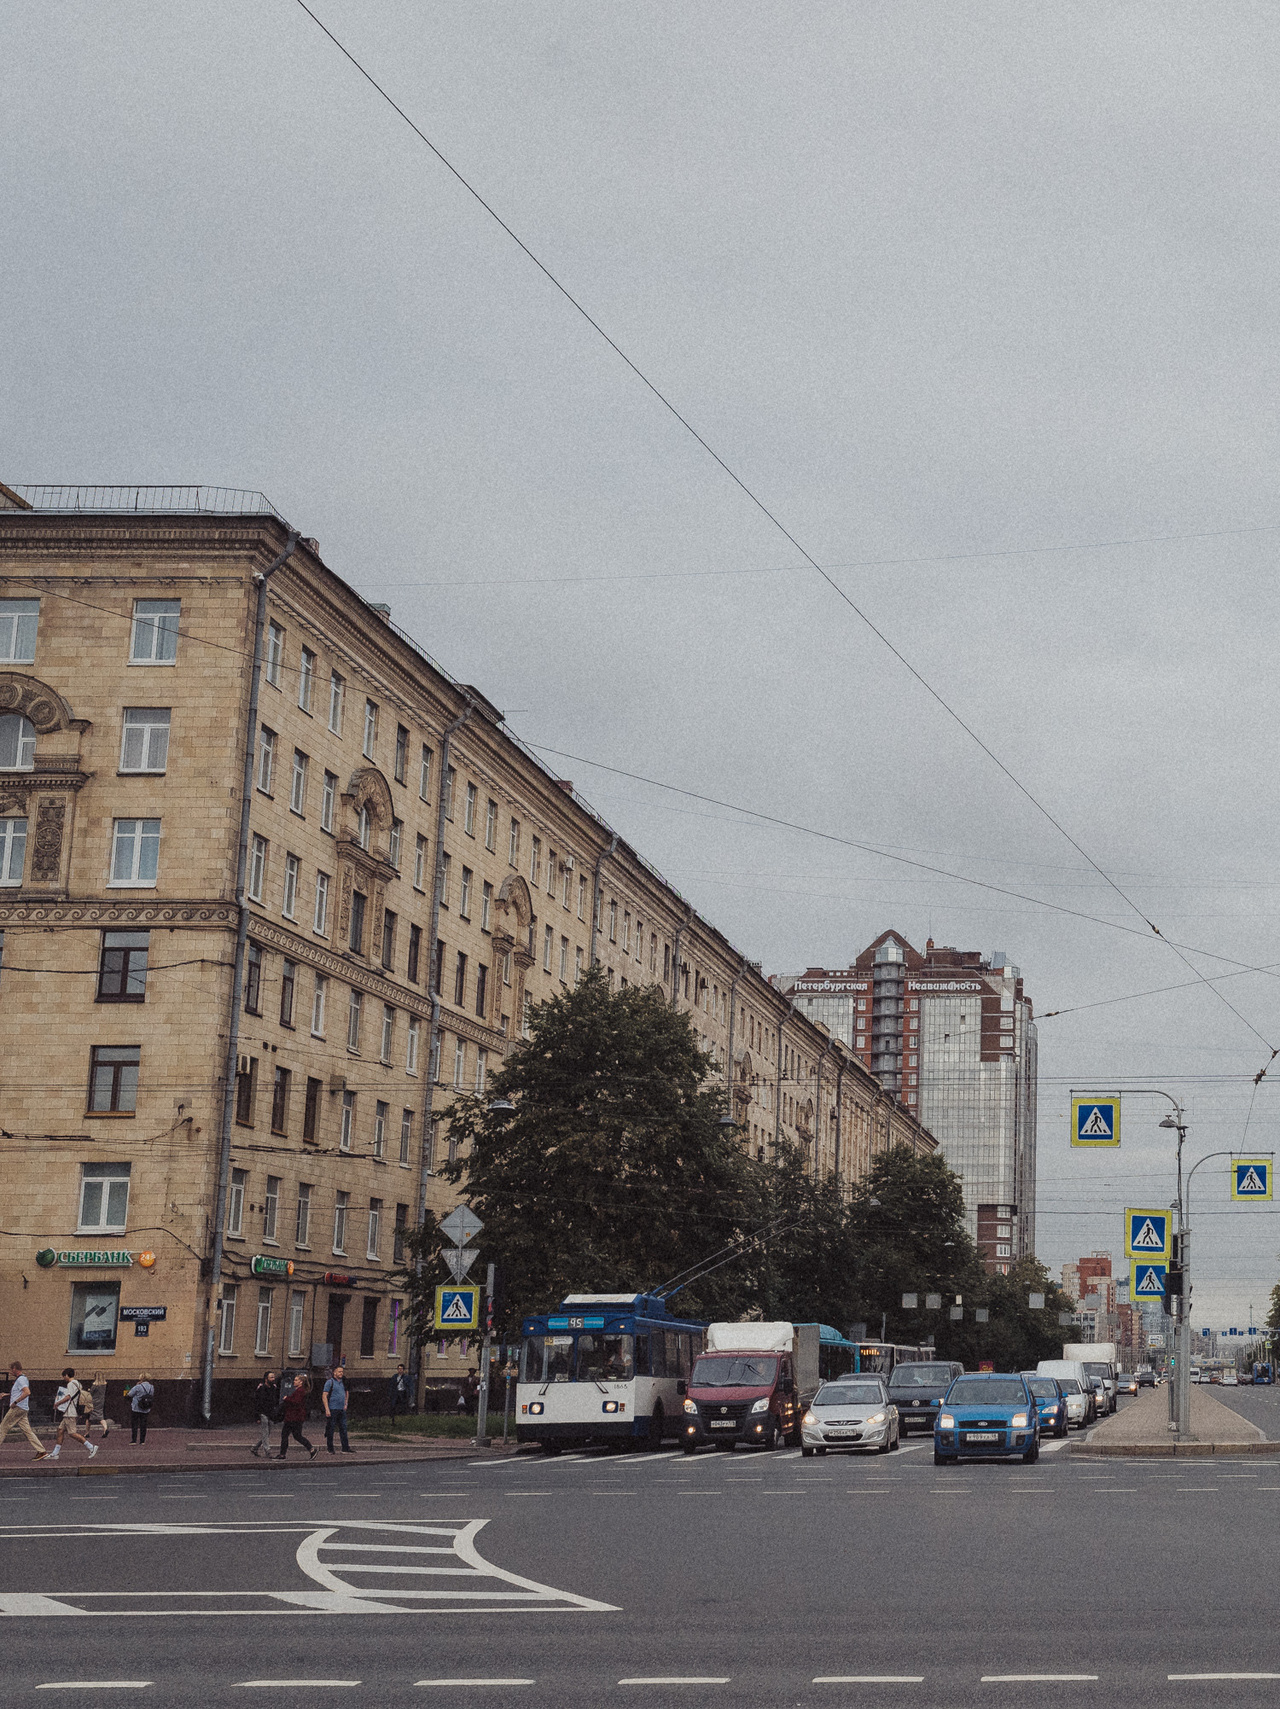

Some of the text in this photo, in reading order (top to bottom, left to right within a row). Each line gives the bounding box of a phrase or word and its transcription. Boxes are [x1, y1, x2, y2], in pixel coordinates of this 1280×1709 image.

[794, 980, 868, 992] Петербургская
[58, 1250, 133, 1263] СБЕРБАНК
[123, 1308, 165, 1316] МОСКОВСКИЙ
